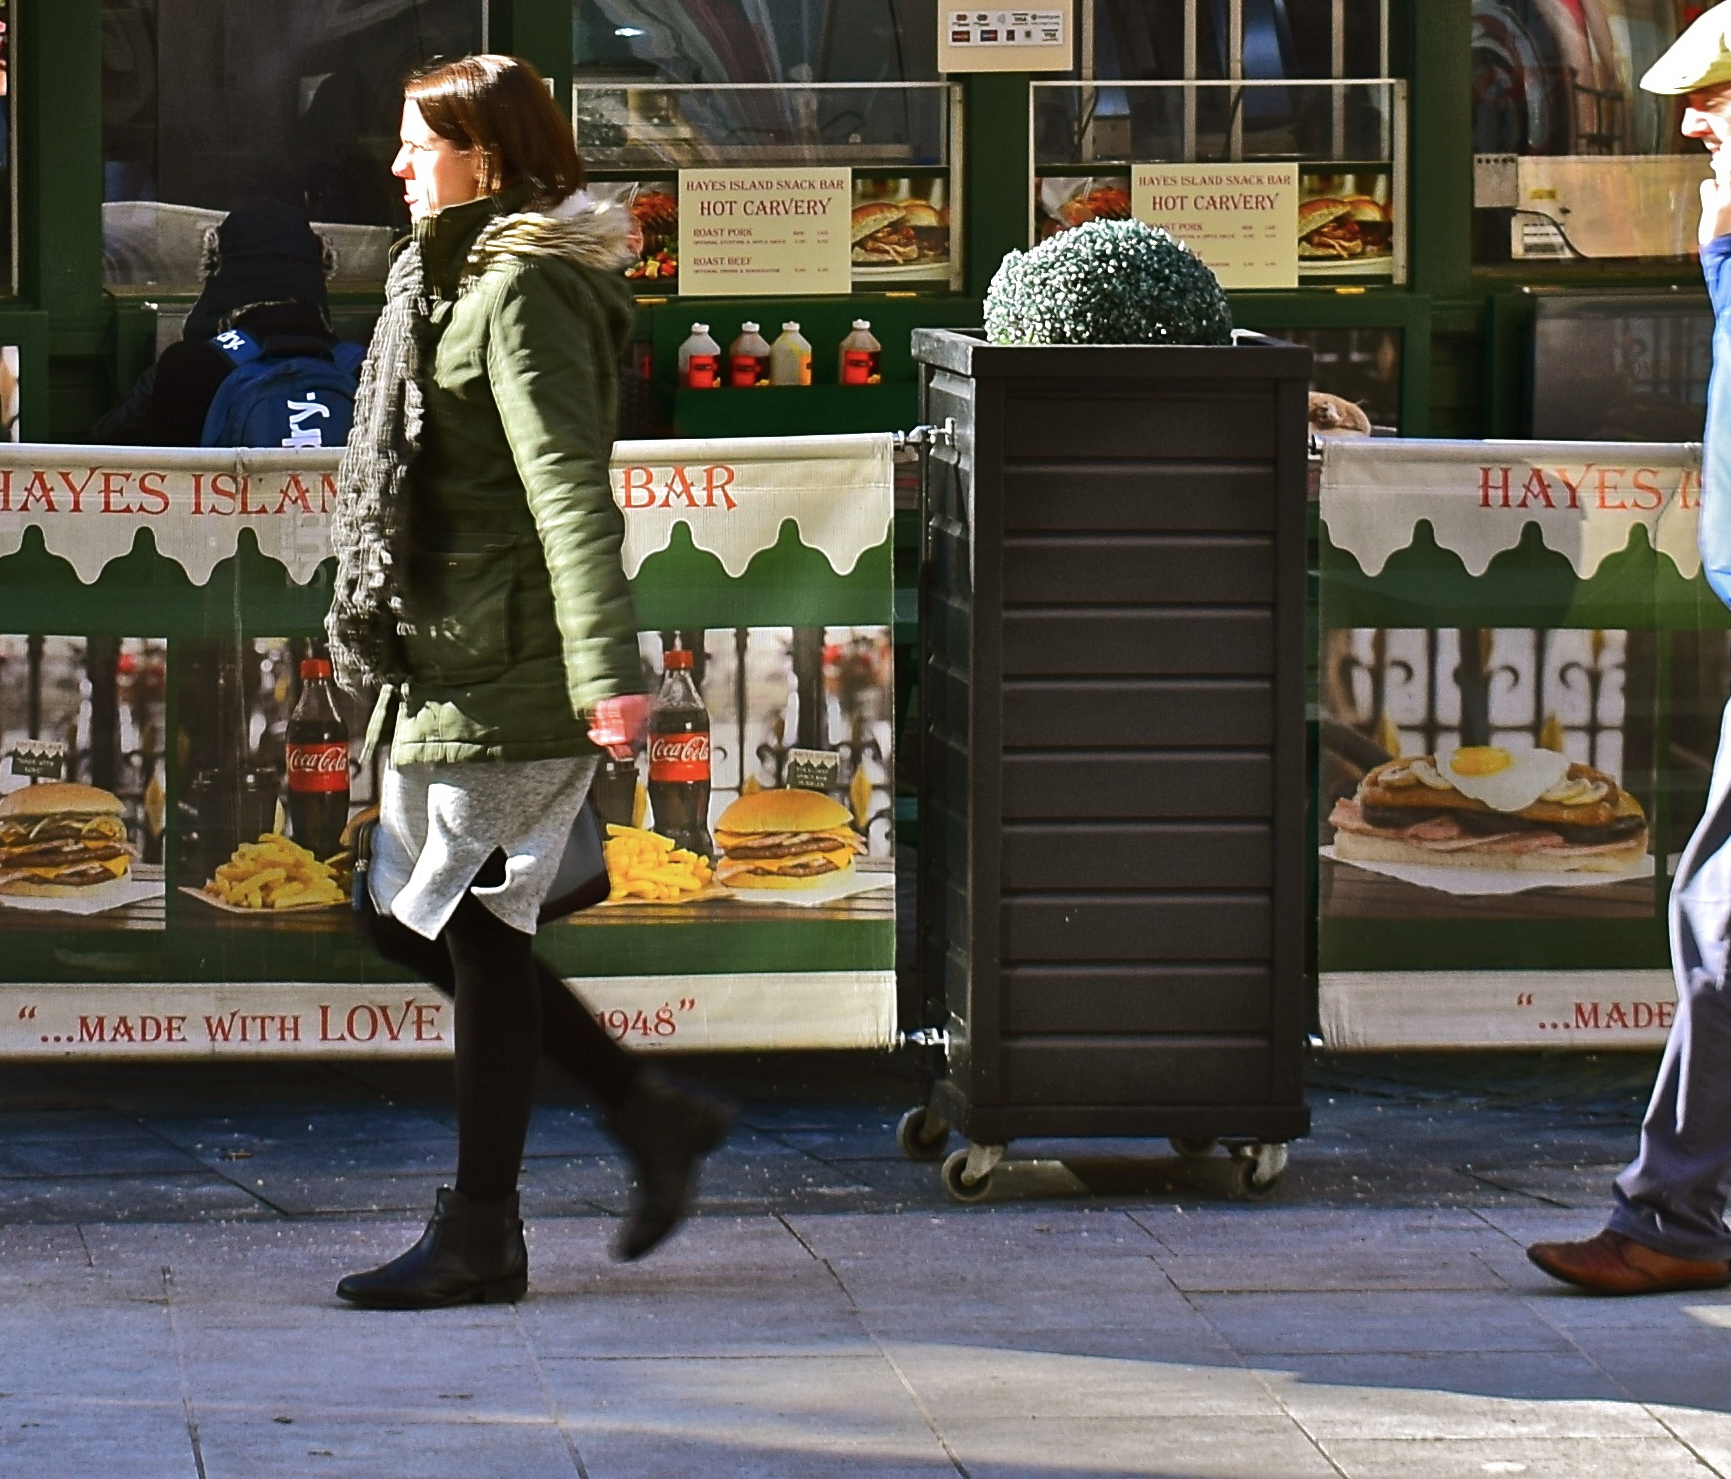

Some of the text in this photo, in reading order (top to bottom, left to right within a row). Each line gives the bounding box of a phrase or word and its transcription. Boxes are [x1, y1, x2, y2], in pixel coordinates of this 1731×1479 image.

[686, 179, 844, 191] HAYES ISLAND SNACK BAR
[1139, 174, 1291, 186] HAYES ISLAND SNACK BAR
[700, 197, 832, 216] HOT CARVERY
[1152, 192, 1279, 211] HOT CARVERY
[620, 463, 738, 512] BAR
[1478, 462, 1664, 510] HAYES
[203, 1008, 301, 1043] WITH
[318, 997, 443, 1043] LOVE
